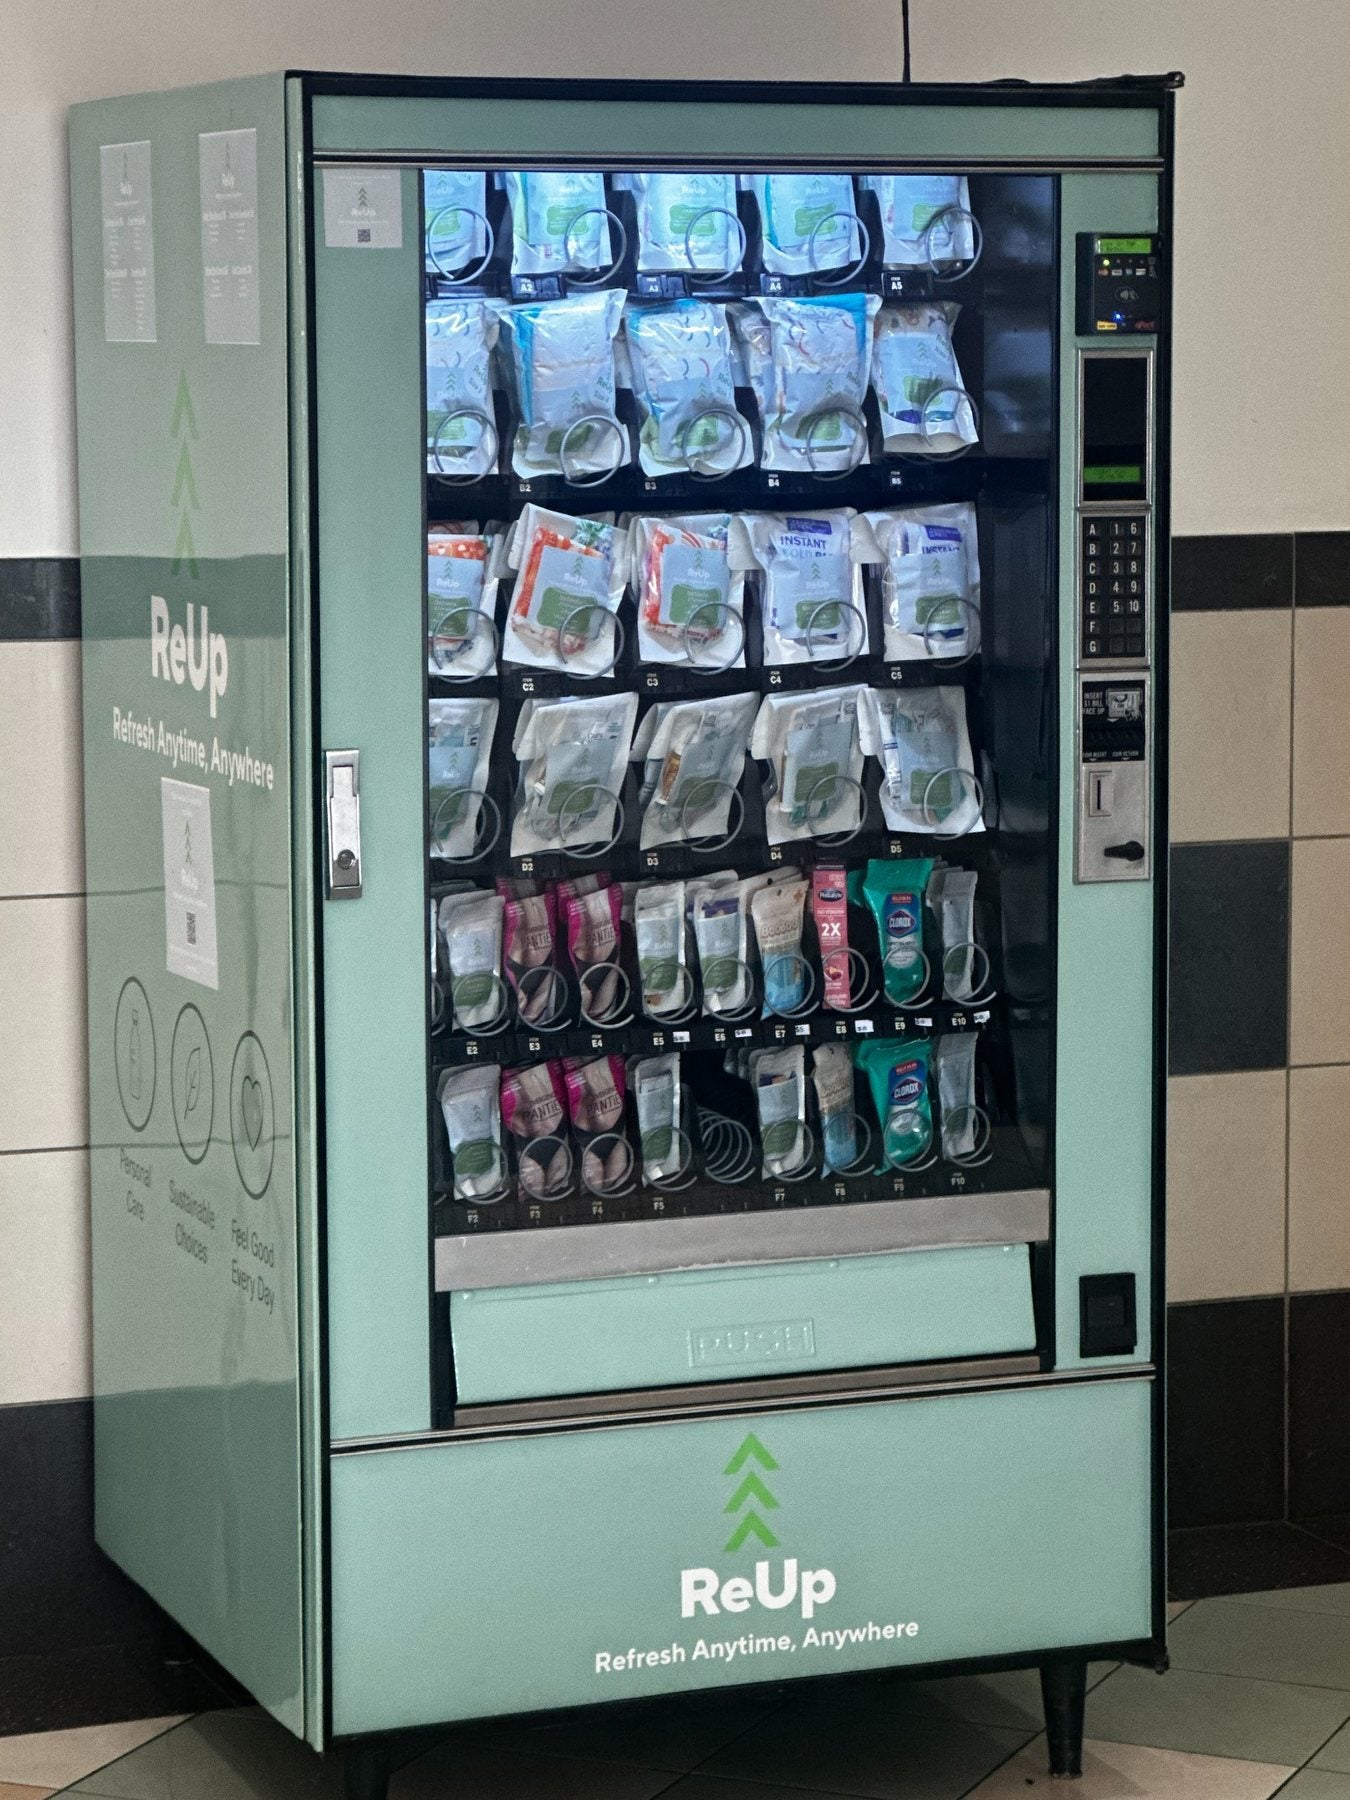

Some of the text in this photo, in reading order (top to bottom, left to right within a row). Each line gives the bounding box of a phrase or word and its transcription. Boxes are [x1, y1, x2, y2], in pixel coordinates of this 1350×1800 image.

[520, 284, 532, 292] A2
[770, 282, 781, 291] A4
[892, 282, 902, 290] A5
[645, 482, 656, 490] B3
[769, 479, 780, 487] B4
[519, 484, 531, 492] B2
[1089, 522, 1137, 536] A 1 6
[780, 536, 826, 550] INSTANT
[1089, 542, 1137, 555] B 2 7
[1089, 561, 1137, 575] C 3 8
[1089, 580, 1137, 594] D 4 9
[1090, 600, 1139, 614] E 5 10
[1090, 621, 1096, 633] F
[1090, 640, 1097, 653] G
[151, 594, 229, 718] ReUp
[770, 676, 781, 685] C4
[890, 672, 902, 680] C5
[646, 678, 658, 686] C3
[522, 683, 534, 691] C2
[112, 706, 274, 790] Refresh Anytime, Anywhere
[891, 845, 902, 853] D5
[771, 852, 782, 861] D4
[647, 857, 659, 866] D3
[522, 863, 533, 872] D2
[889, 917, 912, 928] CLOROX
[821, 923, 841, 937] 2X
[895, 1021, 906, 1030] E9
[952, 1017, 967, 1026] E10
[775, 1029, 785, 1038] E7
[836, 1025, 847, 1034] E8
[653, 1037, 664, 1046] E5
[715, 1033, 726, 1041] E6
[529, 1042, 540, 1050] E3
[592, 1039, 603, 1047] E4
[466, 1046, 478, 1054] E2
[894, 1082, 919, 1099] CLOROX
[119, 1146, 151, 1188] Personal
[951, 1177, 965, 1186] F10
[835, 1187, 845, 1196] F8
[775, 1193, 785, 1202] F7
[126, 1190, 145, 1223] Care
[168, 1179, 215, 1230] Sustainable
[654, 1202, 664, 1210] F5
[530, 1210, 540, 1219] F3
[592, 1206, 603, 1215] F4
[468, 1214, 478, 1223] F2
[175, 1222, 208, 1265] Choices
[231, 1219, 275, 1268] Feel Good
[231, 1259, 275, 1315] Every Day
[681, 1558, 837, 1619] ReUp
[595, 1621, 919, 1674] Refresh Anytime, Anywhere
